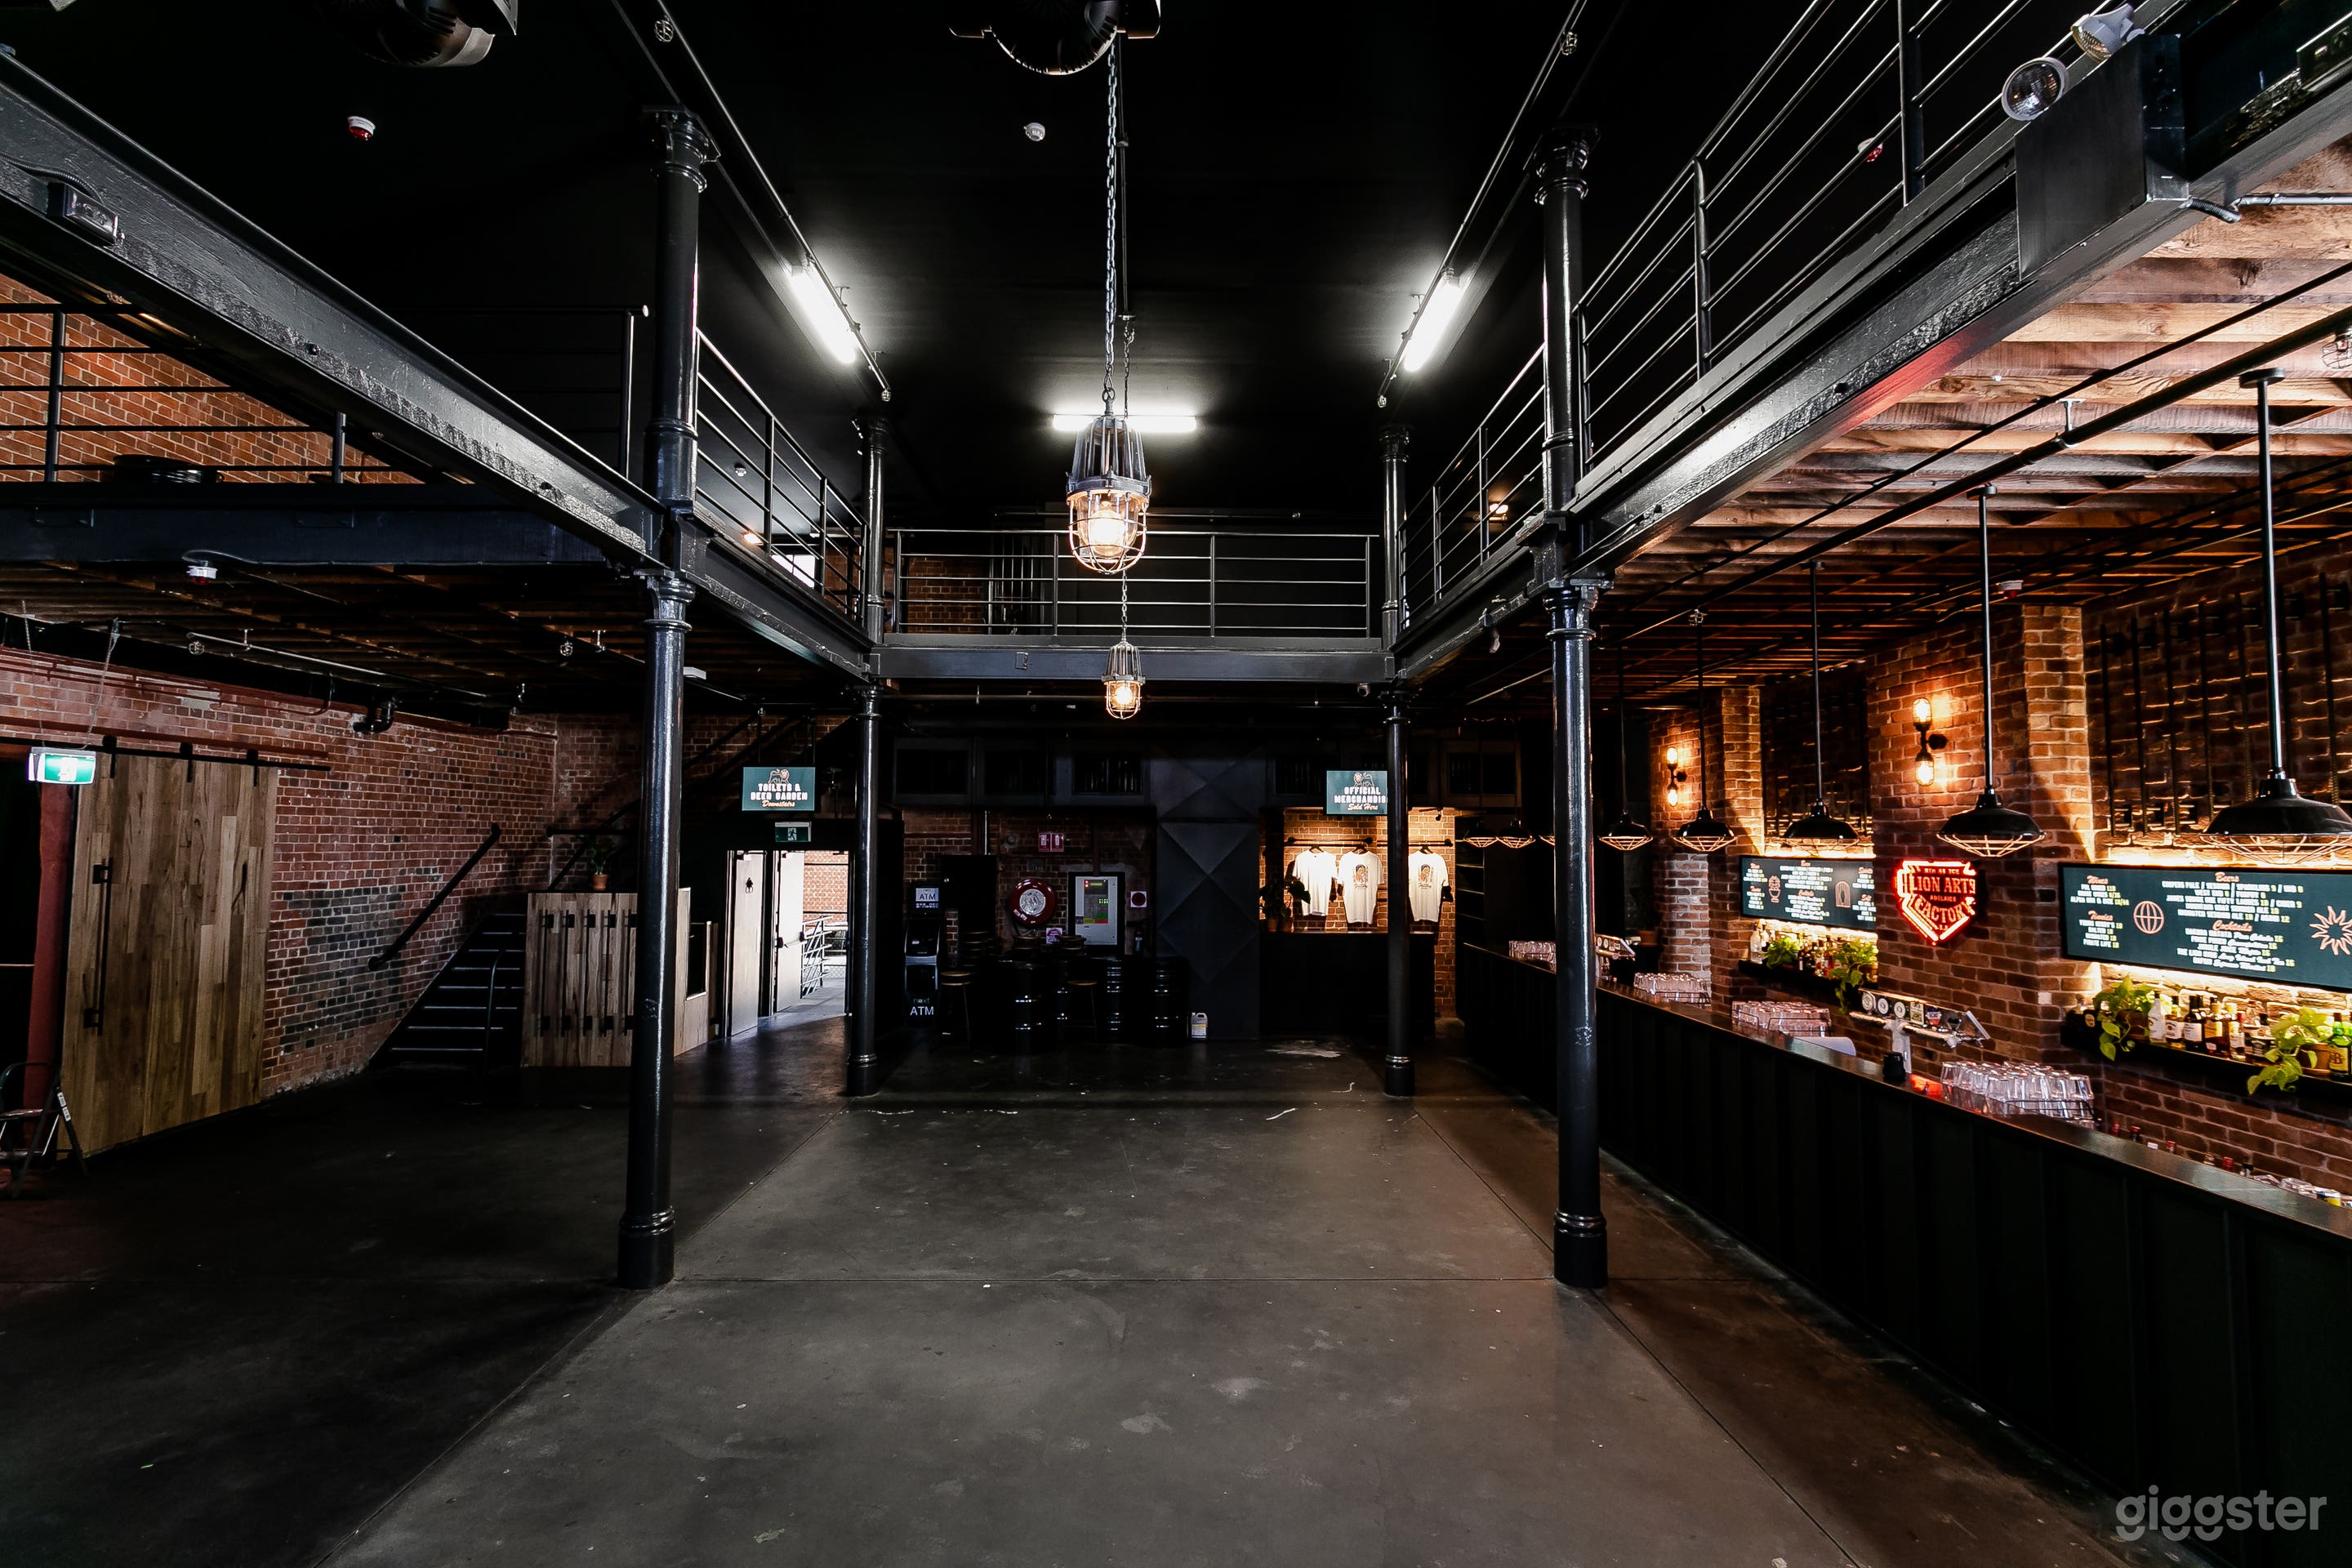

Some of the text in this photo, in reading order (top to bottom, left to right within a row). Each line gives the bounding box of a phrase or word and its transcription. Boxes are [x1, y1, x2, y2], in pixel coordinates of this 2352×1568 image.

[758, 783, 801, 791] TOILETS &
[1343, 786, 1381, 795] OFFICIAL
[750, 791, 808, 800] BEER GARDEN
[1334, 795, 1386, 804] MERCHANDIS
[1910, 875, 1976, 893] LION ARTS
[2212, 920, 2252, 931] Cocktails
[910, 1006, 934, 1016] ATM
